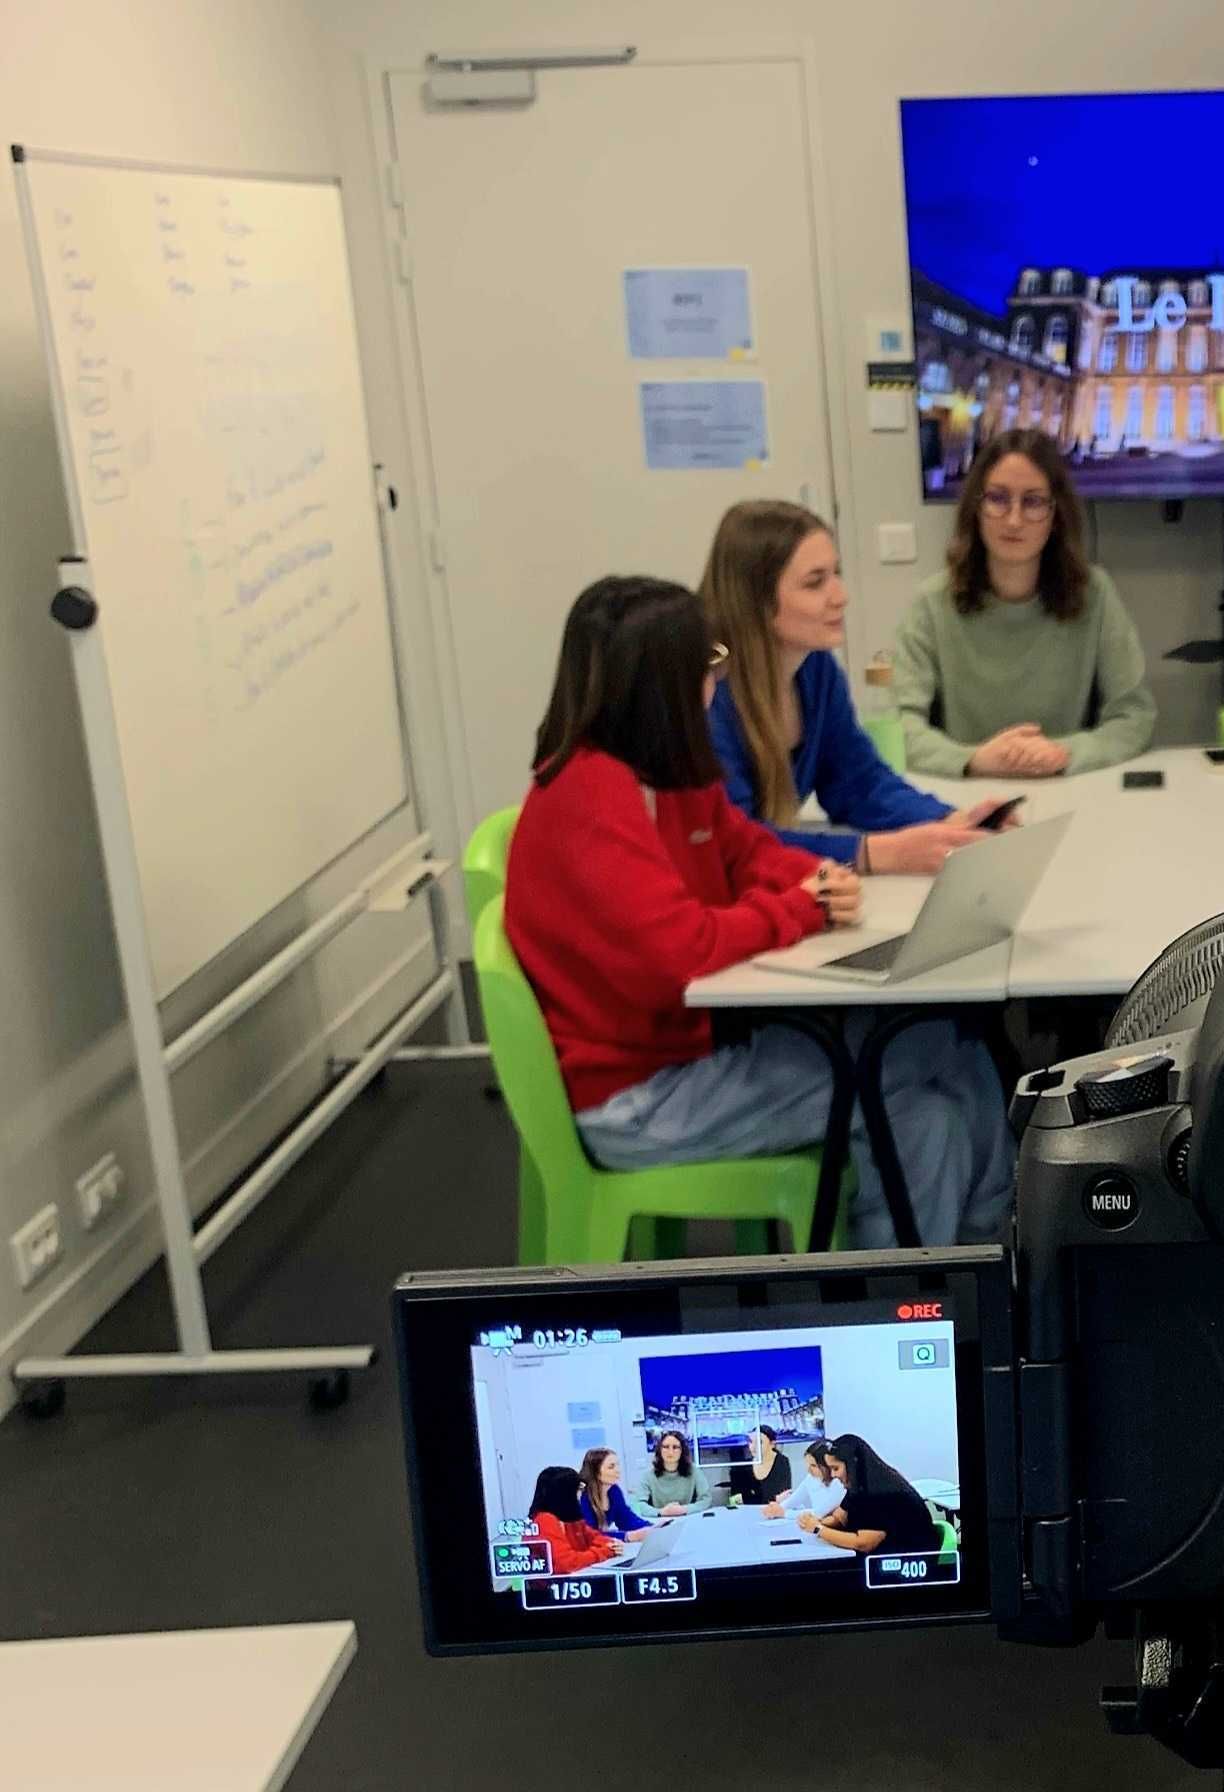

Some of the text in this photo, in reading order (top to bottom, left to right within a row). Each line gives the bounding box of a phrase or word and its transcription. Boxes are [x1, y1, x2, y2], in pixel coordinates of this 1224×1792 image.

[1105, 276, 1187, 332] Le
[1091, 1194, 1131, 1210] MENU
[912, 1303, 943, 1318] REC
[532, 1328, 589, 1349] 01:26
[498, 1559, 546, 1573] SERVO AF
[901, 1560, 927, 1578] 400
[550, 1582, 592, 1600] 1/50
[638, 1577, 679, 1595] F4.5
